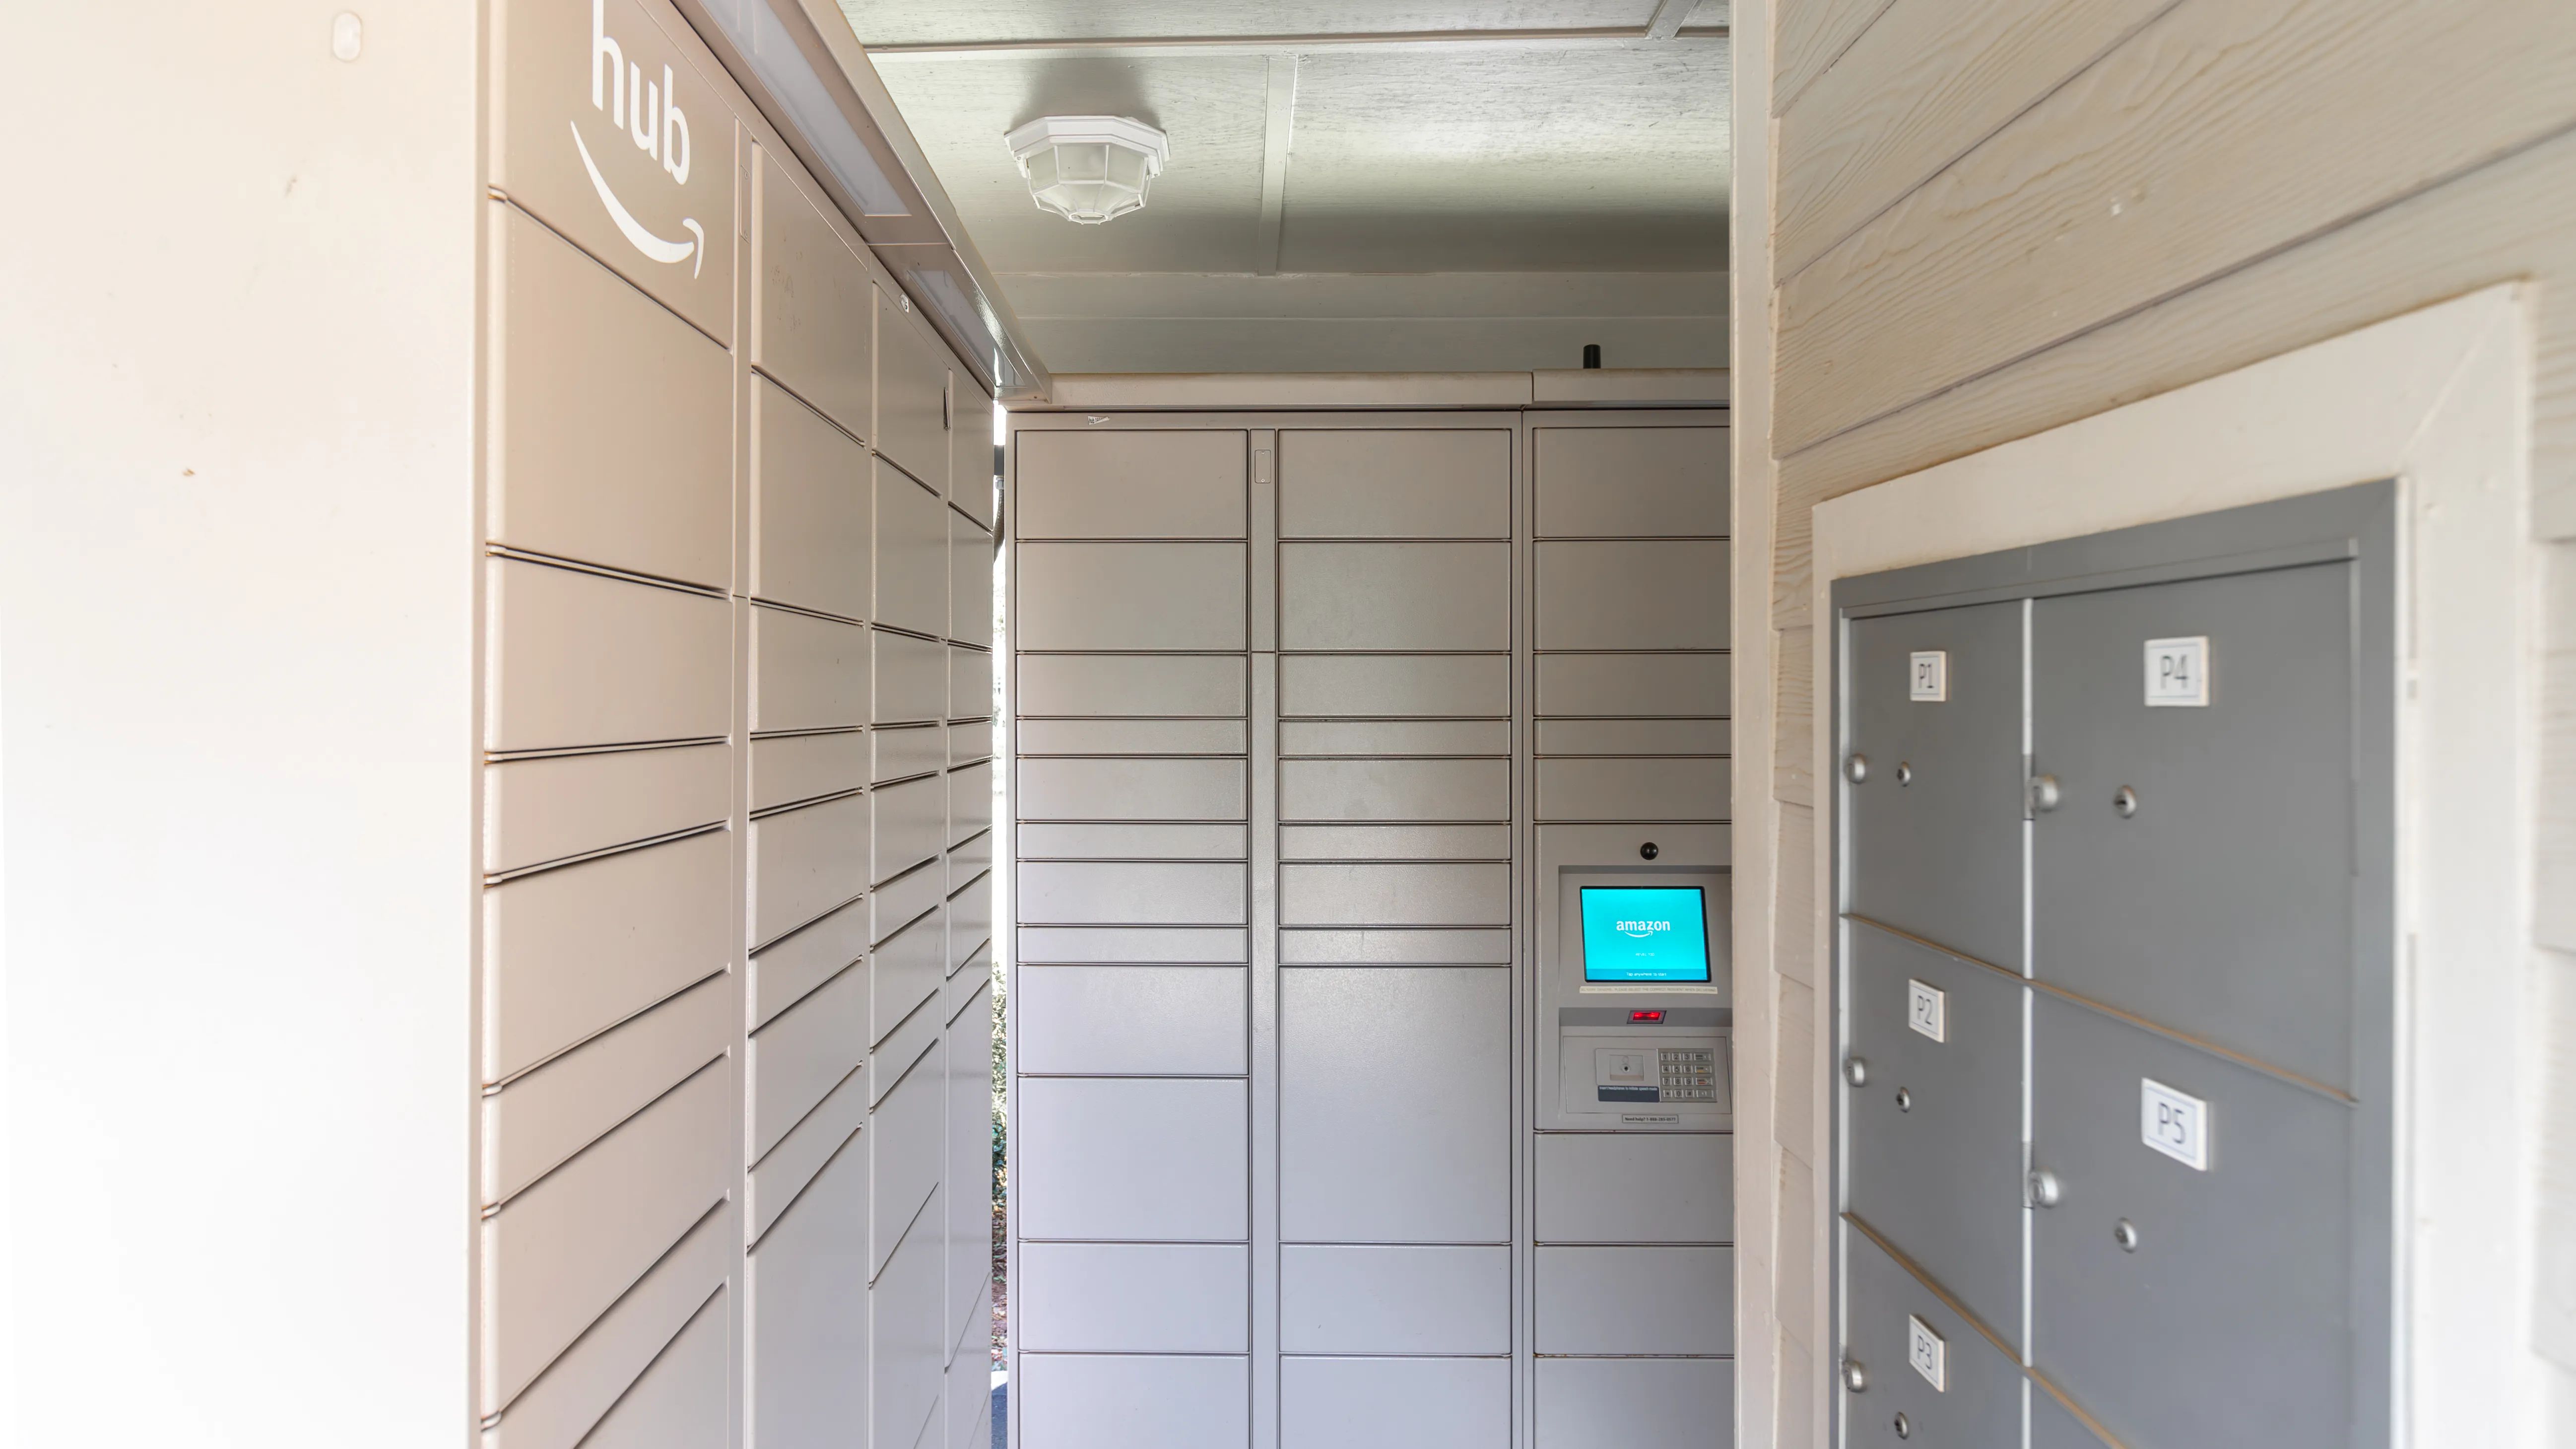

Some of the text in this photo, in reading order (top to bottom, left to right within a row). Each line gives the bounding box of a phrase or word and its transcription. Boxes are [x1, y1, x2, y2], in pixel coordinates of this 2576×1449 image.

[592, 0, 690, 185] hub
[1918, 663, 1934, 689] P1
[2160, 655, 2187, 689] P4
[1616, 920, 1670, 931] amazon
[1917, 995, 1932, 1025] P2
[2159, 1102, 2185, 1144] P5
[1918, 1335, 1932, 1370] P3
